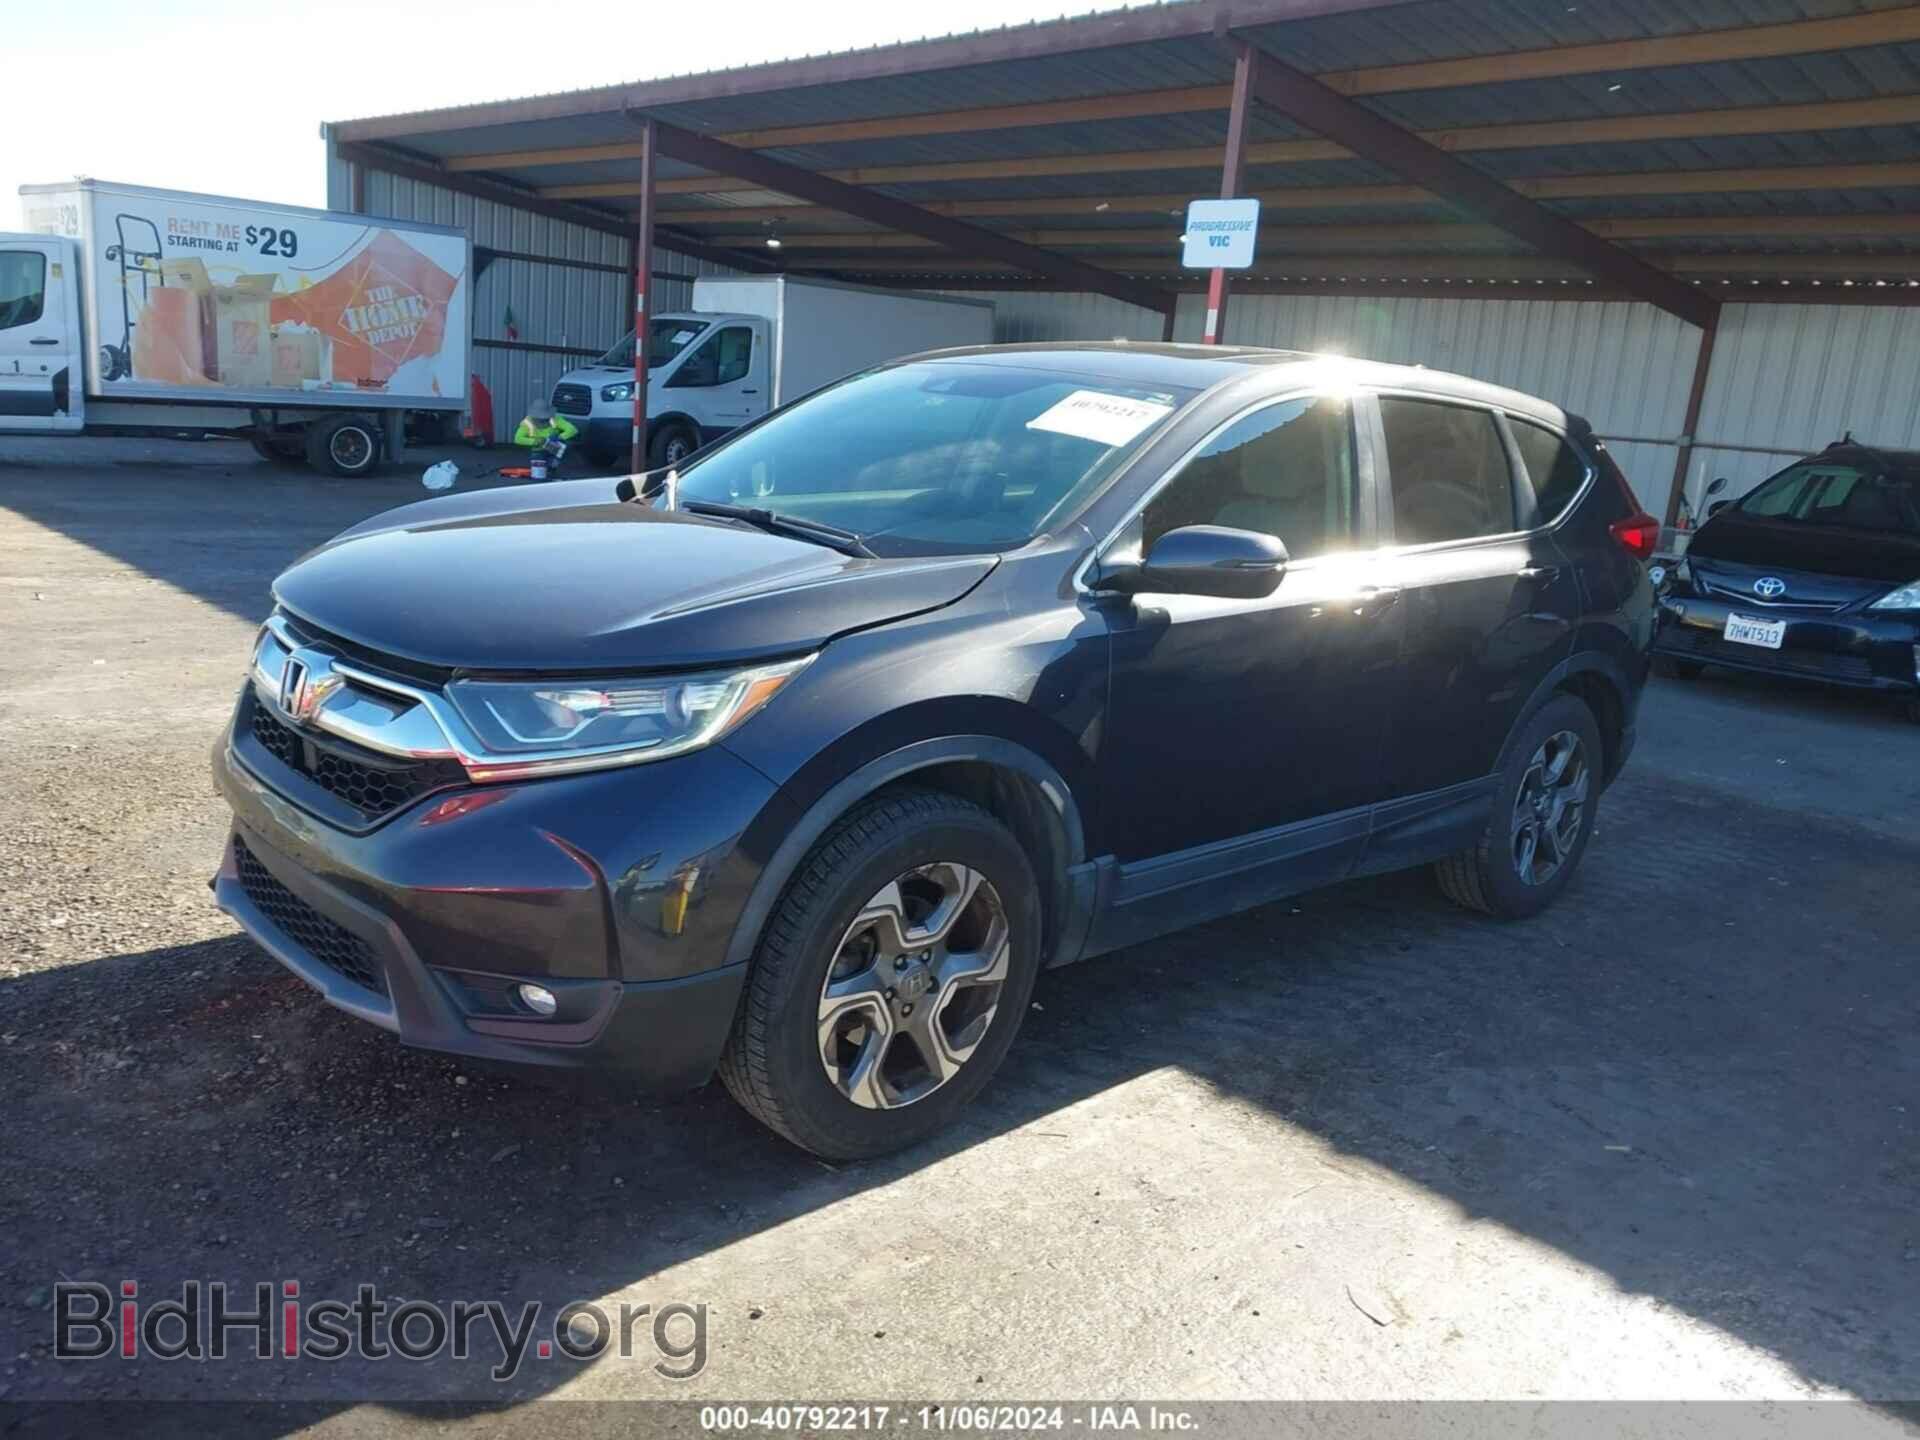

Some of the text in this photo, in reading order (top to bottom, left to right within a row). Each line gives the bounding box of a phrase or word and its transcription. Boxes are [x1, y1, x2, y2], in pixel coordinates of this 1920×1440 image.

[167, 217, 240, 240] RENT ME
[1189, 220, 1254, 232] PROGRESSIVE
[167, 234, 239, 253] STARTING AT
[245, 224, 298, 258] $29
[1208, 234, 1231, 247] VIC
[1729, 623, 1779, 644] 7HWT513
